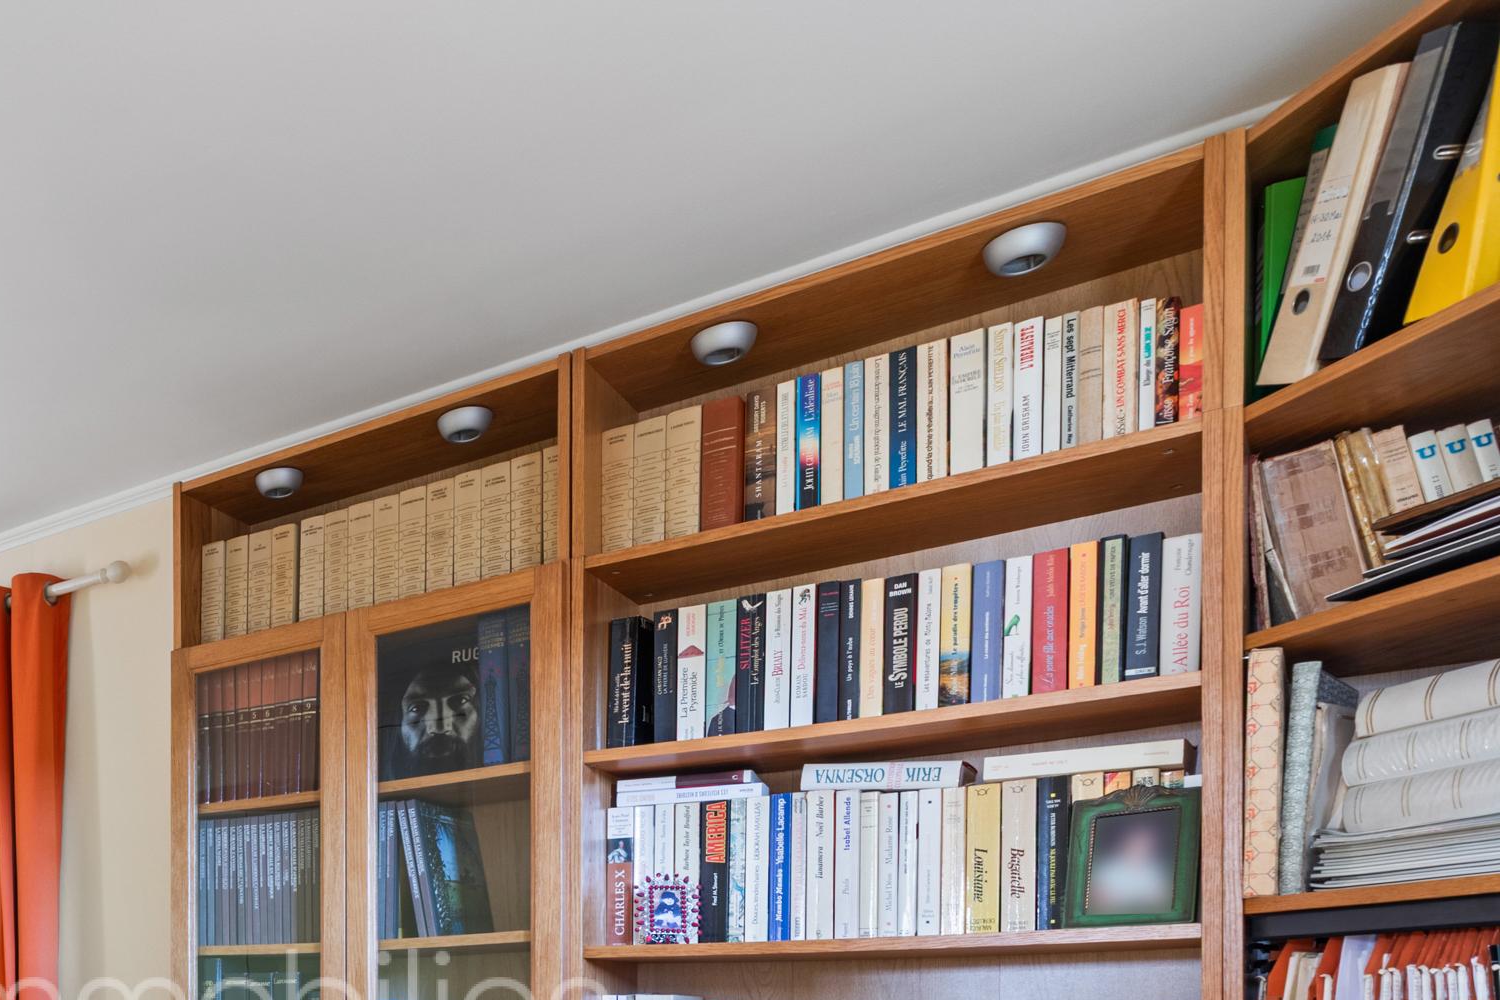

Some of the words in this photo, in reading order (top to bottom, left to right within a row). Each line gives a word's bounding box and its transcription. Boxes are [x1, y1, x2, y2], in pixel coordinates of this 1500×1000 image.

[1066, 318, 1077, 333] Les
[1117, 309, 1126, 333] MERCI
[1065, 336, 1075, 353] sept
[1117, 336, 1126, 356] SANS
[1065, 356, 1076, 399] Mitterrand
[1117, 359, 1126, 394] COMBAT
[755, 440, 763, 498] SHANTARAM
[1138, 552, 1150, 574] dormir
[1136, 594, 1149, 614] Avant
[1173, 585, 1190, 609] Roi
[892, 607, 909, 637] PERDU
[1135, 617, 1148, 641] Watson
[1174, 612, 1189, 628] du
[739, 617, 751, 670] SULITZER
[888, 638, 908, 681] SYMBOLE
[689, 671, 699, 712] Pyramide
[679, 706, 688, 718] La
[815, 767, 885, 784] ORSENNA
[904, 766, 942, 782] ERIK
[843, 796, 851, 825] Allende
[705, 800, 727, 863] AMERICA
[843, 827, 851, 851] Isabel
[614, 869, 625, 879] X
[973, 848, 988, 903] Louisiane
[1008, 848, 1025, 899] Bagatelle
[614, 880, 625, 936] CHARLES
